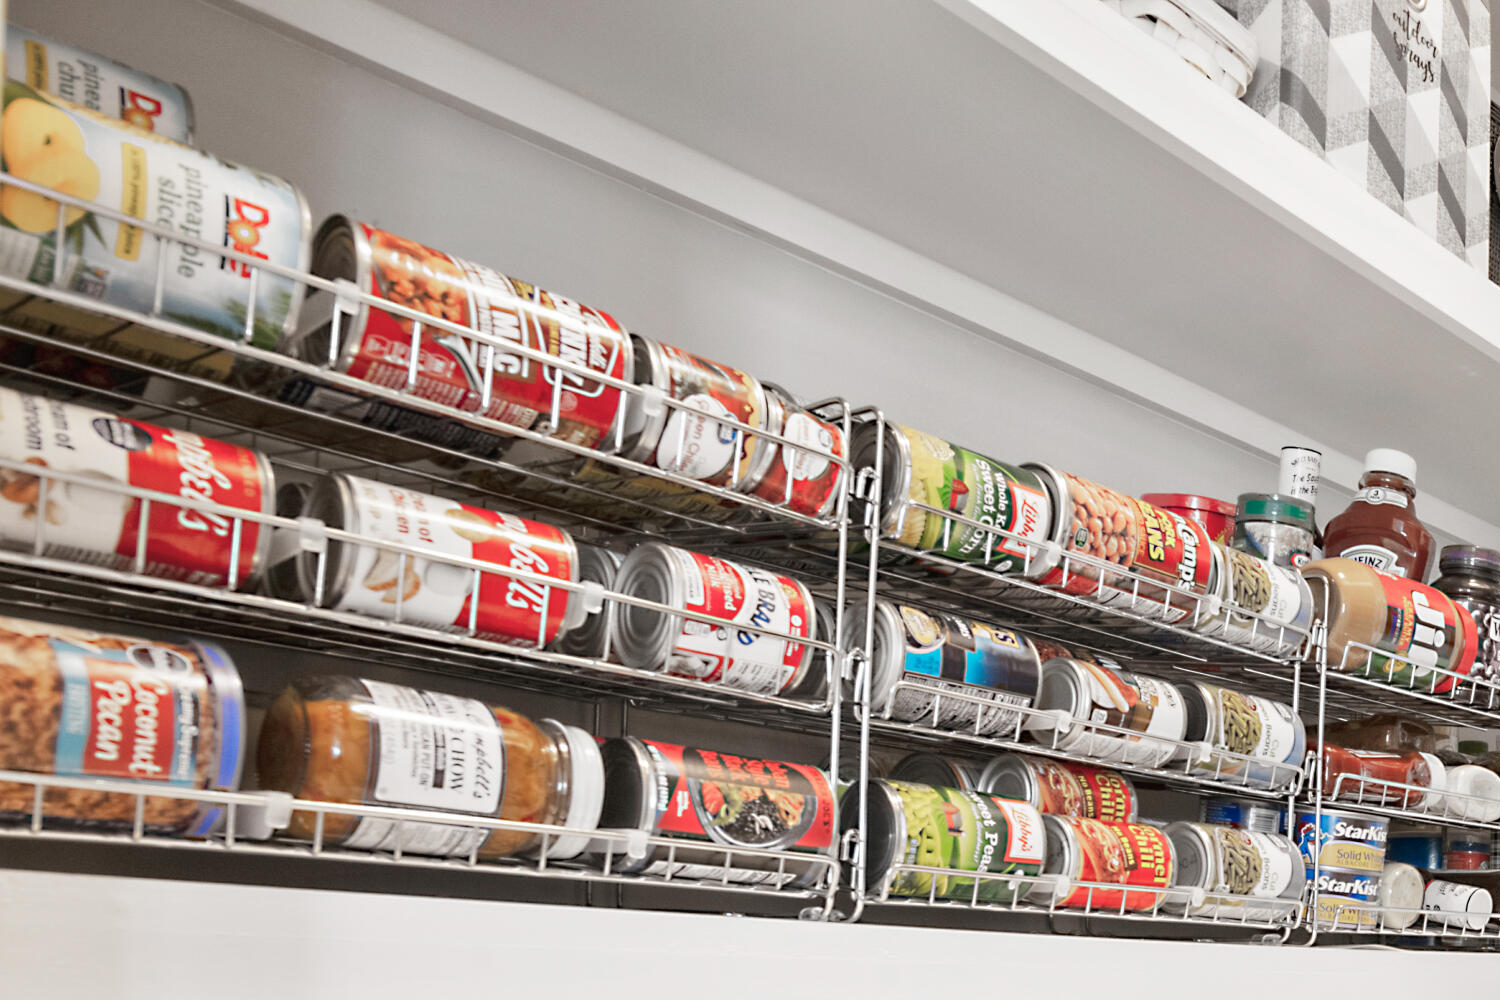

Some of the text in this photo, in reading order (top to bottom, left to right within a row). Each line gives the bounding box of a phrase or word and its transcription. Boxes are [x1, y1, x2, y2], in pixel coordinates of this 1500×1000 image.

[975, 458, 996, 514] Sweet
[994, 472, 1009, 512] Whole
[94, 680, 131, 760] Pecan
[129, 676, 170, 775] Coconut
[1121, 836, 1136, 866] Beans
[1128, 825, 1156, 869] Chili
[1337, 848, 1361, 861] Solid
